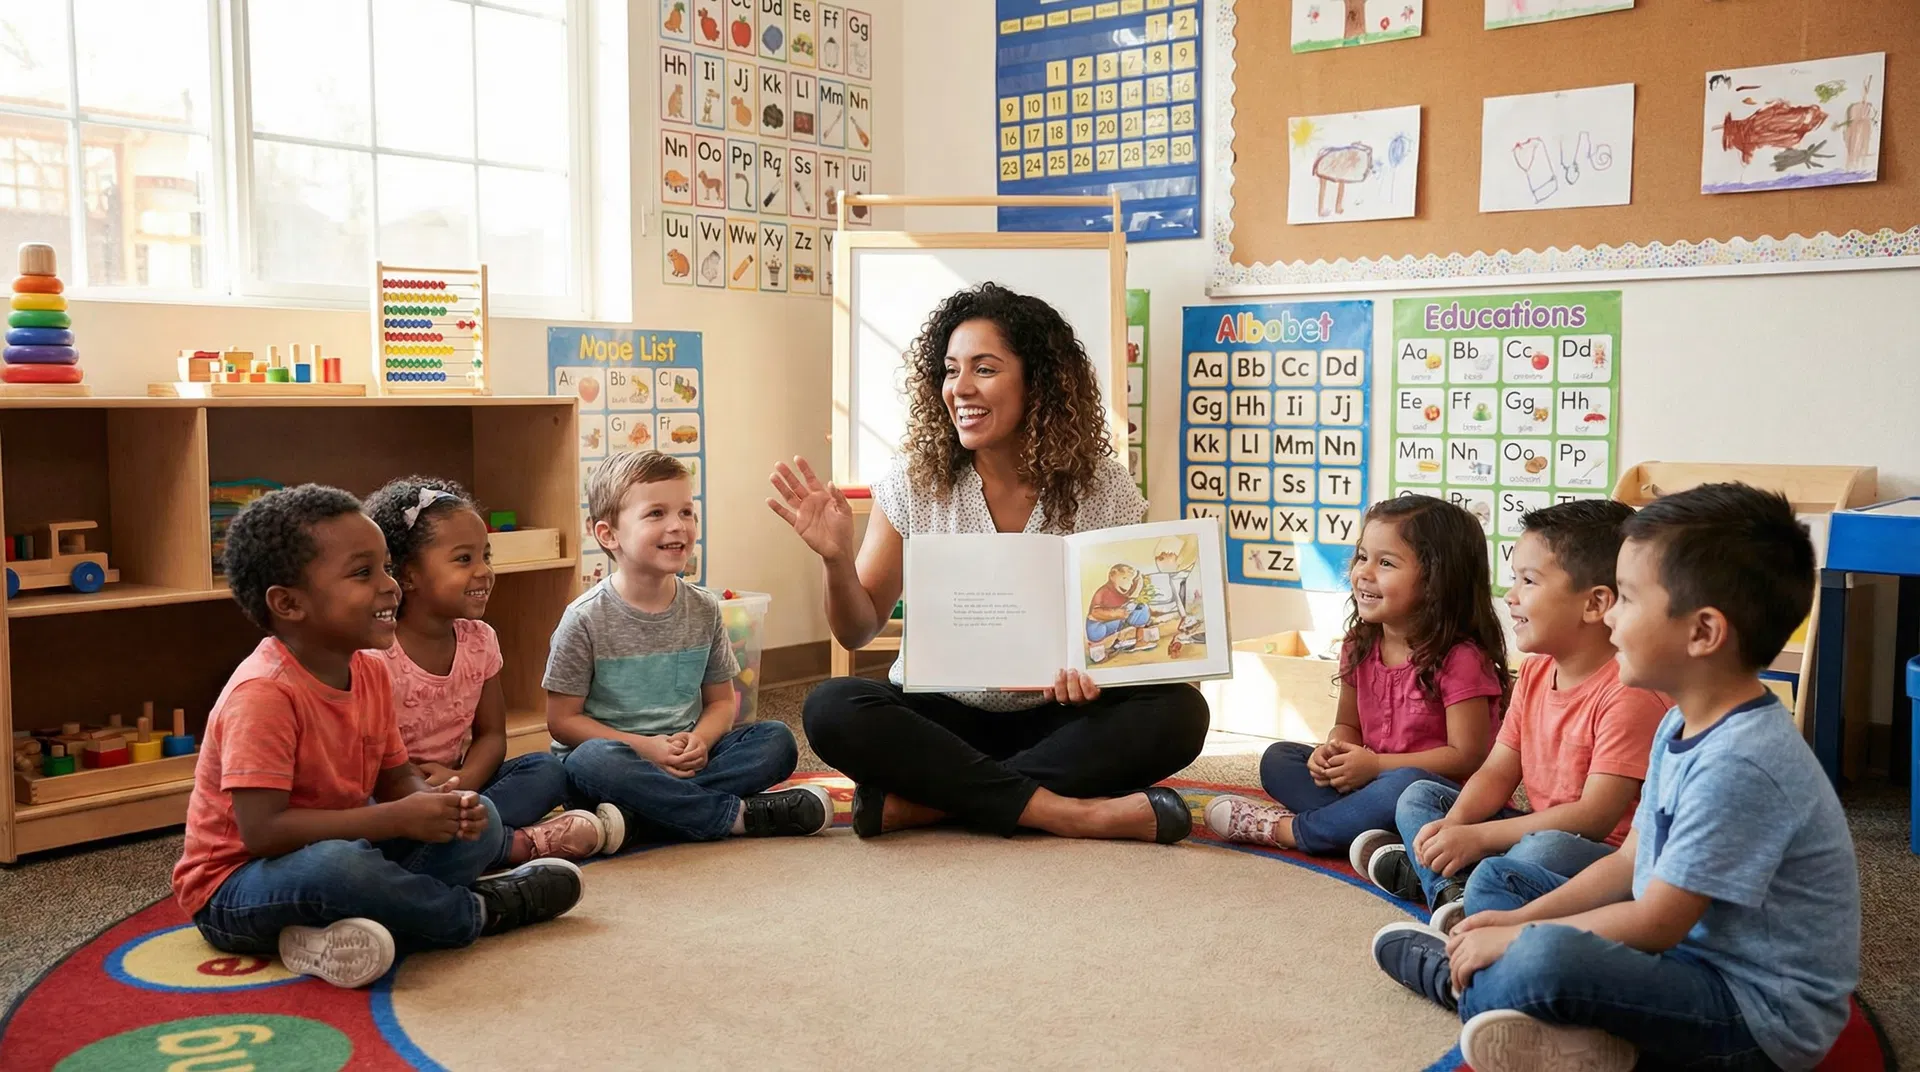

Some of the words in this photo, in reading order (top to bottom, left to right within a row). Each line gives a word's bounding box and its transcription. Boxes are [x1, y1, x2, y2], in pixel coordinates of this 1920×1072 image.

[794, 4, 811, 22] Ee
[824, 11, 839, 29] Ff
[849, 17, 869, 41] Gg
[1154, 20, 1159, 34] 1
[1180, 16, 1188, 30] 2
[1055, 66, 1059, 80] 1
[1079, 63, 1087, 77] 2
[1103, 60, 1112, 73] 3
[1128, 56, 1136, 70] 7
[1154, 51, 1162, 65] 8
[1180, 48, 1188, 61] 9
[665, 55, 687, 76] Hh
[704, 62, 715, 81] Ii
[734, 68, 748, 93] Jj
[763, 74, 782, 94] Kk
[797, 80, 809, 99] Ll
[821, 86, 844, 105] Mm
[850, 92, 869, 110] Nn
[1006, 103, 1014, 117] 9
[1028, 100, 1040, 113] 10
[1052, 97, 1062, 110] 11
[1076, 93, 1089, 107] 12
[1101, 90, 1113, 104] 13
[1126, 87, 1139, 101] 14
[1150, 84, 1164, 97] 15
[1177, 78, 1190, 93] 16
[1005, 132, 1017, 146] 16
[1027, 129, 1040, 143] 17
[1051, 126, 1063, 140] 18
[1076, 123, 1089, 137] 19
[1099, 121, 1115, 134] 20
[1125, 117, 1138, 131] 21
[1149, 114, 1165, 128] 22
[1174, 111, 1191, 126] 23
[665, 137, 688, 158] Nn
[698, 142, 721, 162] Oo
[732, 147, 752, 171] Pp
[764, 151, 781, 178] Rq
[795, 156, 812, 175] Ss
[825, 160, 840, 178] Tt
[1003, 162, 1018, 176] 23
[1027, 158, 1041, 172] 24
[1051, 156, 1065, 170] 25
[1075, 154, 1090, 167] 26
[1099, 151, 1114, 164] 27
[1124, 148, 1140, 161] 28
[1149, 145, 1165, 158] 29
[1174, 142, 1191, 156] 30
[666, 218, 689, 239] Uu
[701, 222, 721, 242] Vv
[729, 225, 756, 245] Ww
[764, 228, 783, 251] Xy
[795, 232, 812, 250] Zz
[1217, 312, 1332, 343] Albobet
[1426, 302, 1586, 331] Educations
[640, 334, 677, 362] List
[1402, 343, 1428, 360] Aa
[1454, 343, 1479, 360] Bb
[1507, 341, 1533, 359] Cc
[1563, 340, 1591, 358] Dd
[611, 372, 626, 386] Bb
[1194, 359, 1222, 378] Aa
[1238, 358, 1265, 377] Bb
[1282, 358, 1310, 377] Cc
[1326, 356, 1357, 377] Dd
[1193, 397, 1222, 420] Gg
[1237, 397, 1265, 416] Hh
[1288, 396, 1303, 416] Ii
[1331, 396, 1351, 422] Jj
[1401, 393, 1422, 410] Ee
[1453, 393, 1471, 410] Ff
[1506, 393, 1535, 415] Gg
[1562, 393, 1589, 410] Hh
[1194, 434, 1220, 454] Kk
[1242, 434, 1259, 454] Ll
[1276, 435, 1314, 456] Mm
[1325, 437, 1356, 456] Nn
[1400, 443, 1434, 460] Mm
[1452, 443, 1478, 461] Nn
[1504, 444, 1535, 461] Oo
[1560, 445, 1586, 467] Pp
[1191, 472, 1224, 496] Qq
[1238, 473, 1261, 492] Rr
[1283, 474, 1306, 493] Ss
[1329, 476, 1351, 495] Tt
[1504, 494, 1524, 513] Ss
[1231, 511, 1268, 530] Ww
[1280, 513, 1308, 533] Xx
[1326, 515, 1352, 541] Yy
[1268, 551, 1294, 572] Zz
